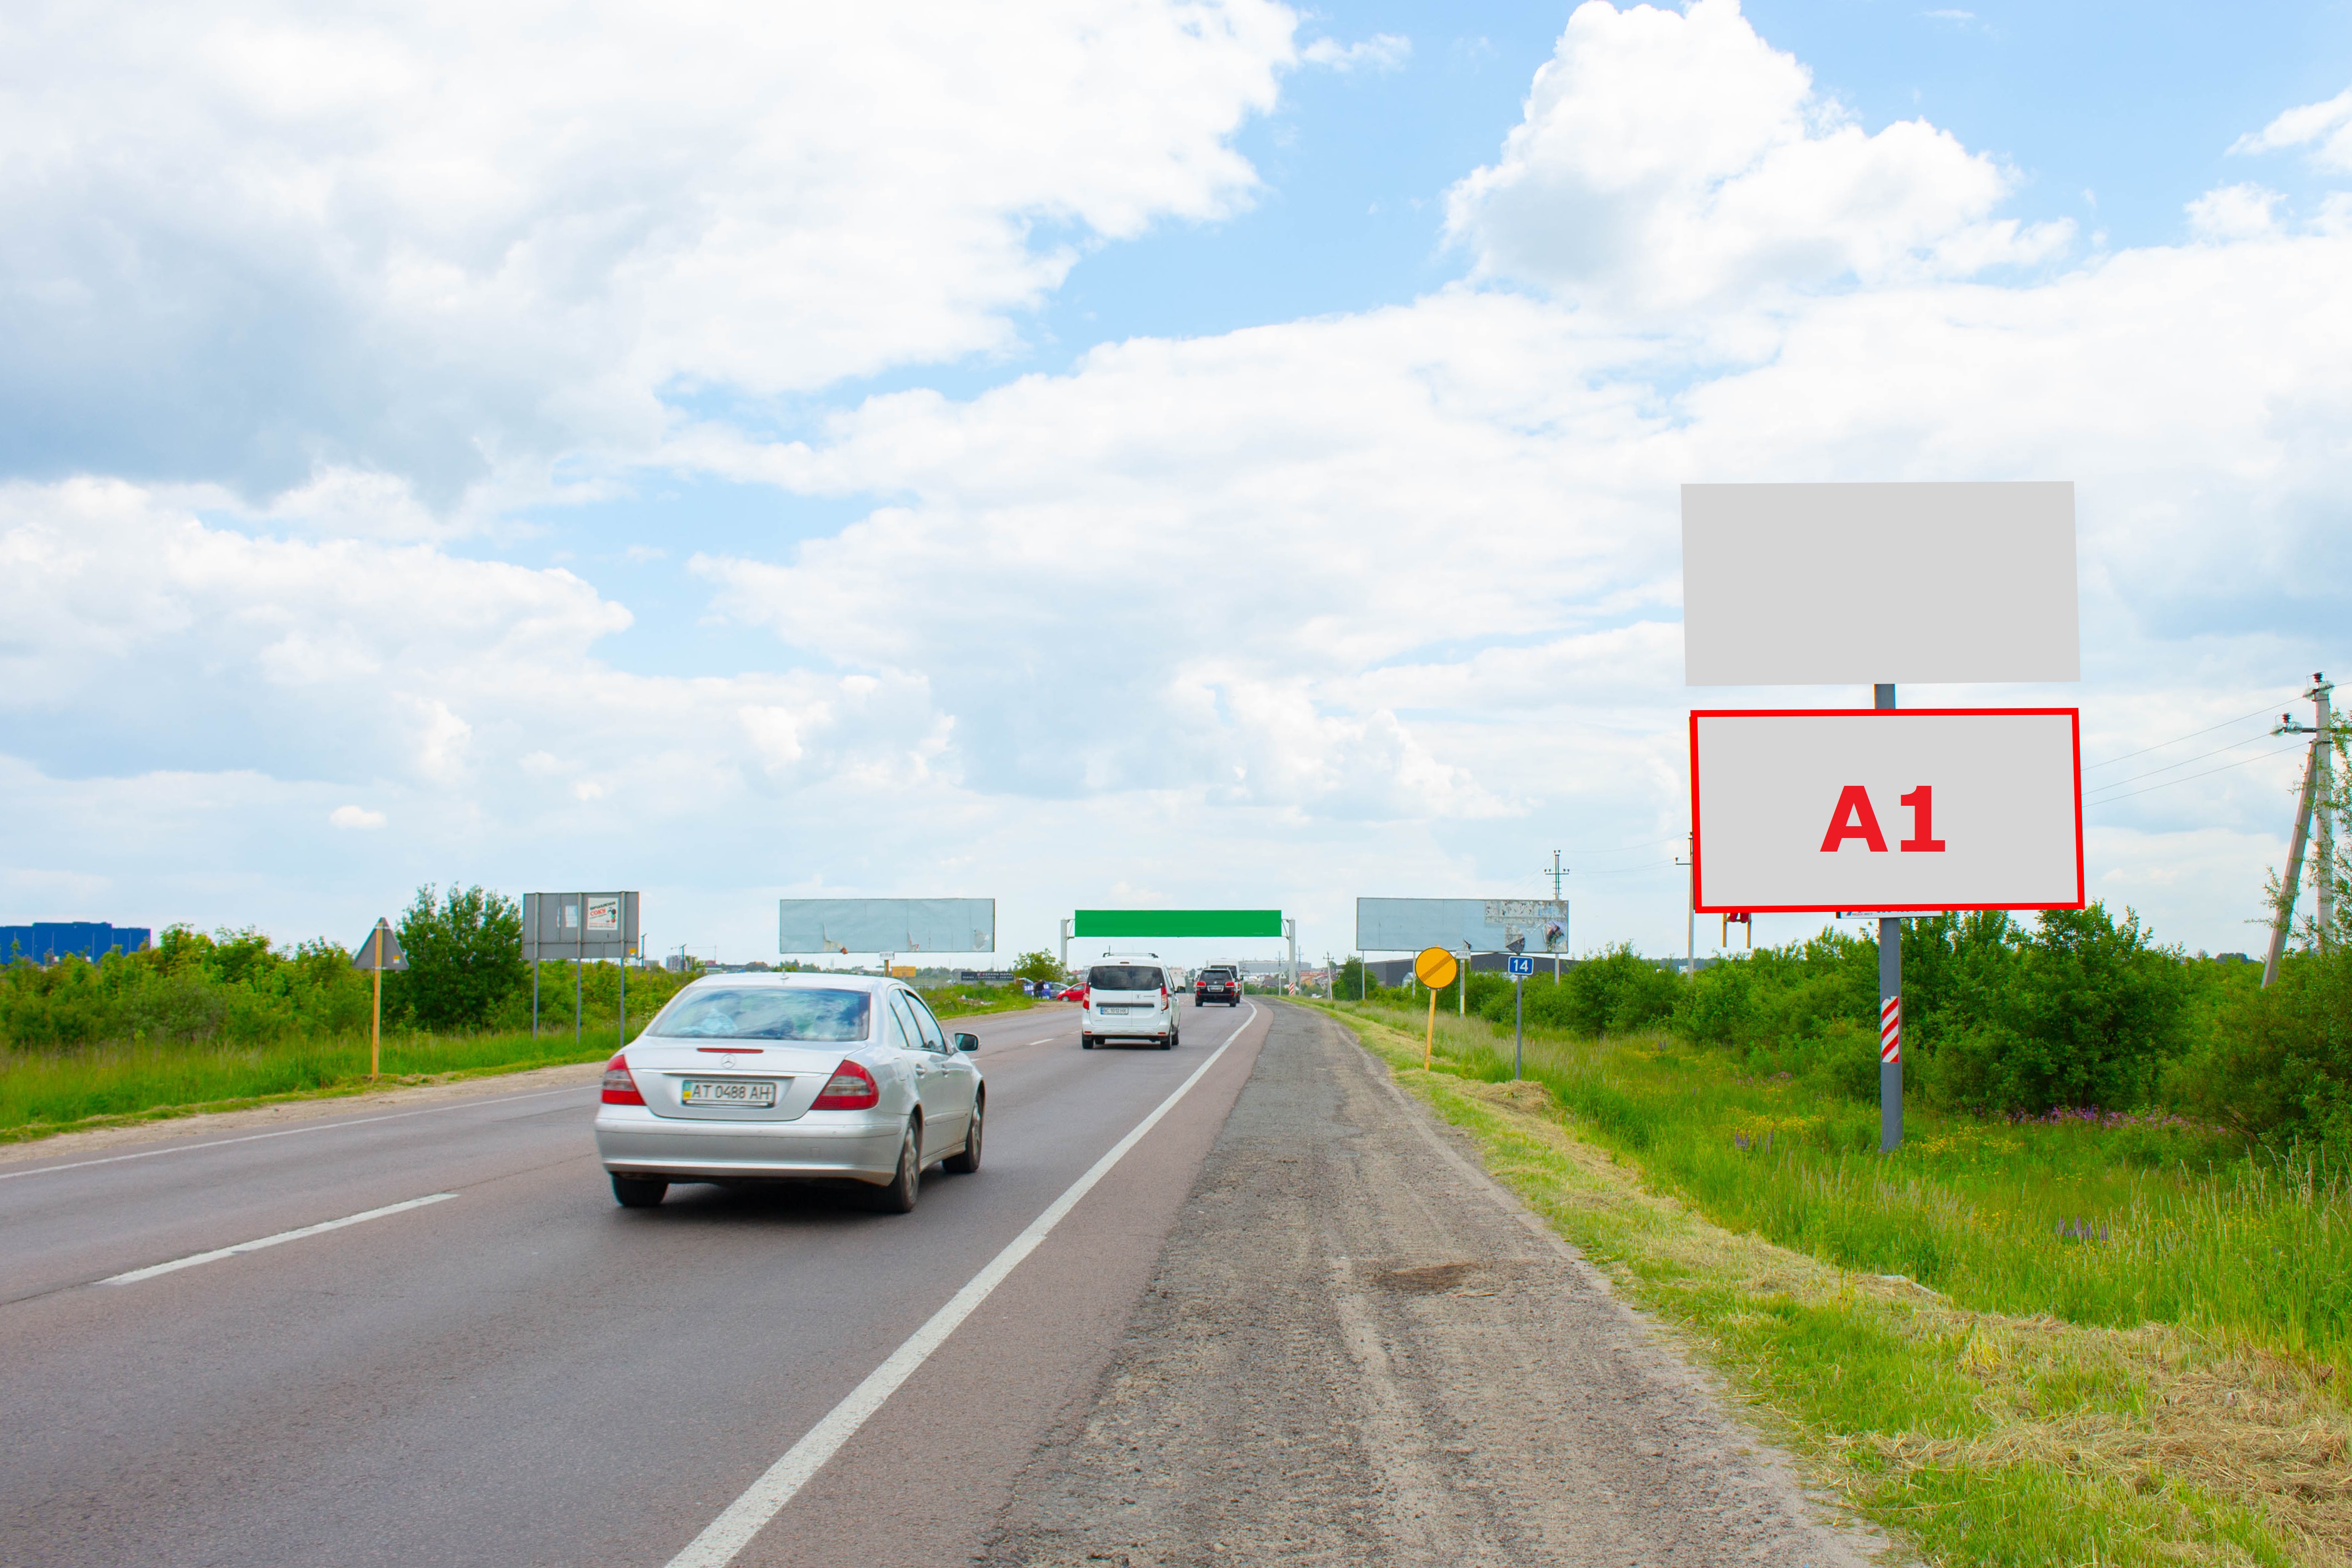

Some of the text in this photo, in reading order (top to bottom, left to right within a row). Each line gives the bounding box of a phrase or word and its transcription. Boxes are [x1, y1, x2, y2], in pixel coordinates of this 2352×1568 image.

[1513, 959, 1529, 972] 14
[692, 1084, 771, 1099] AT 0488 AH
